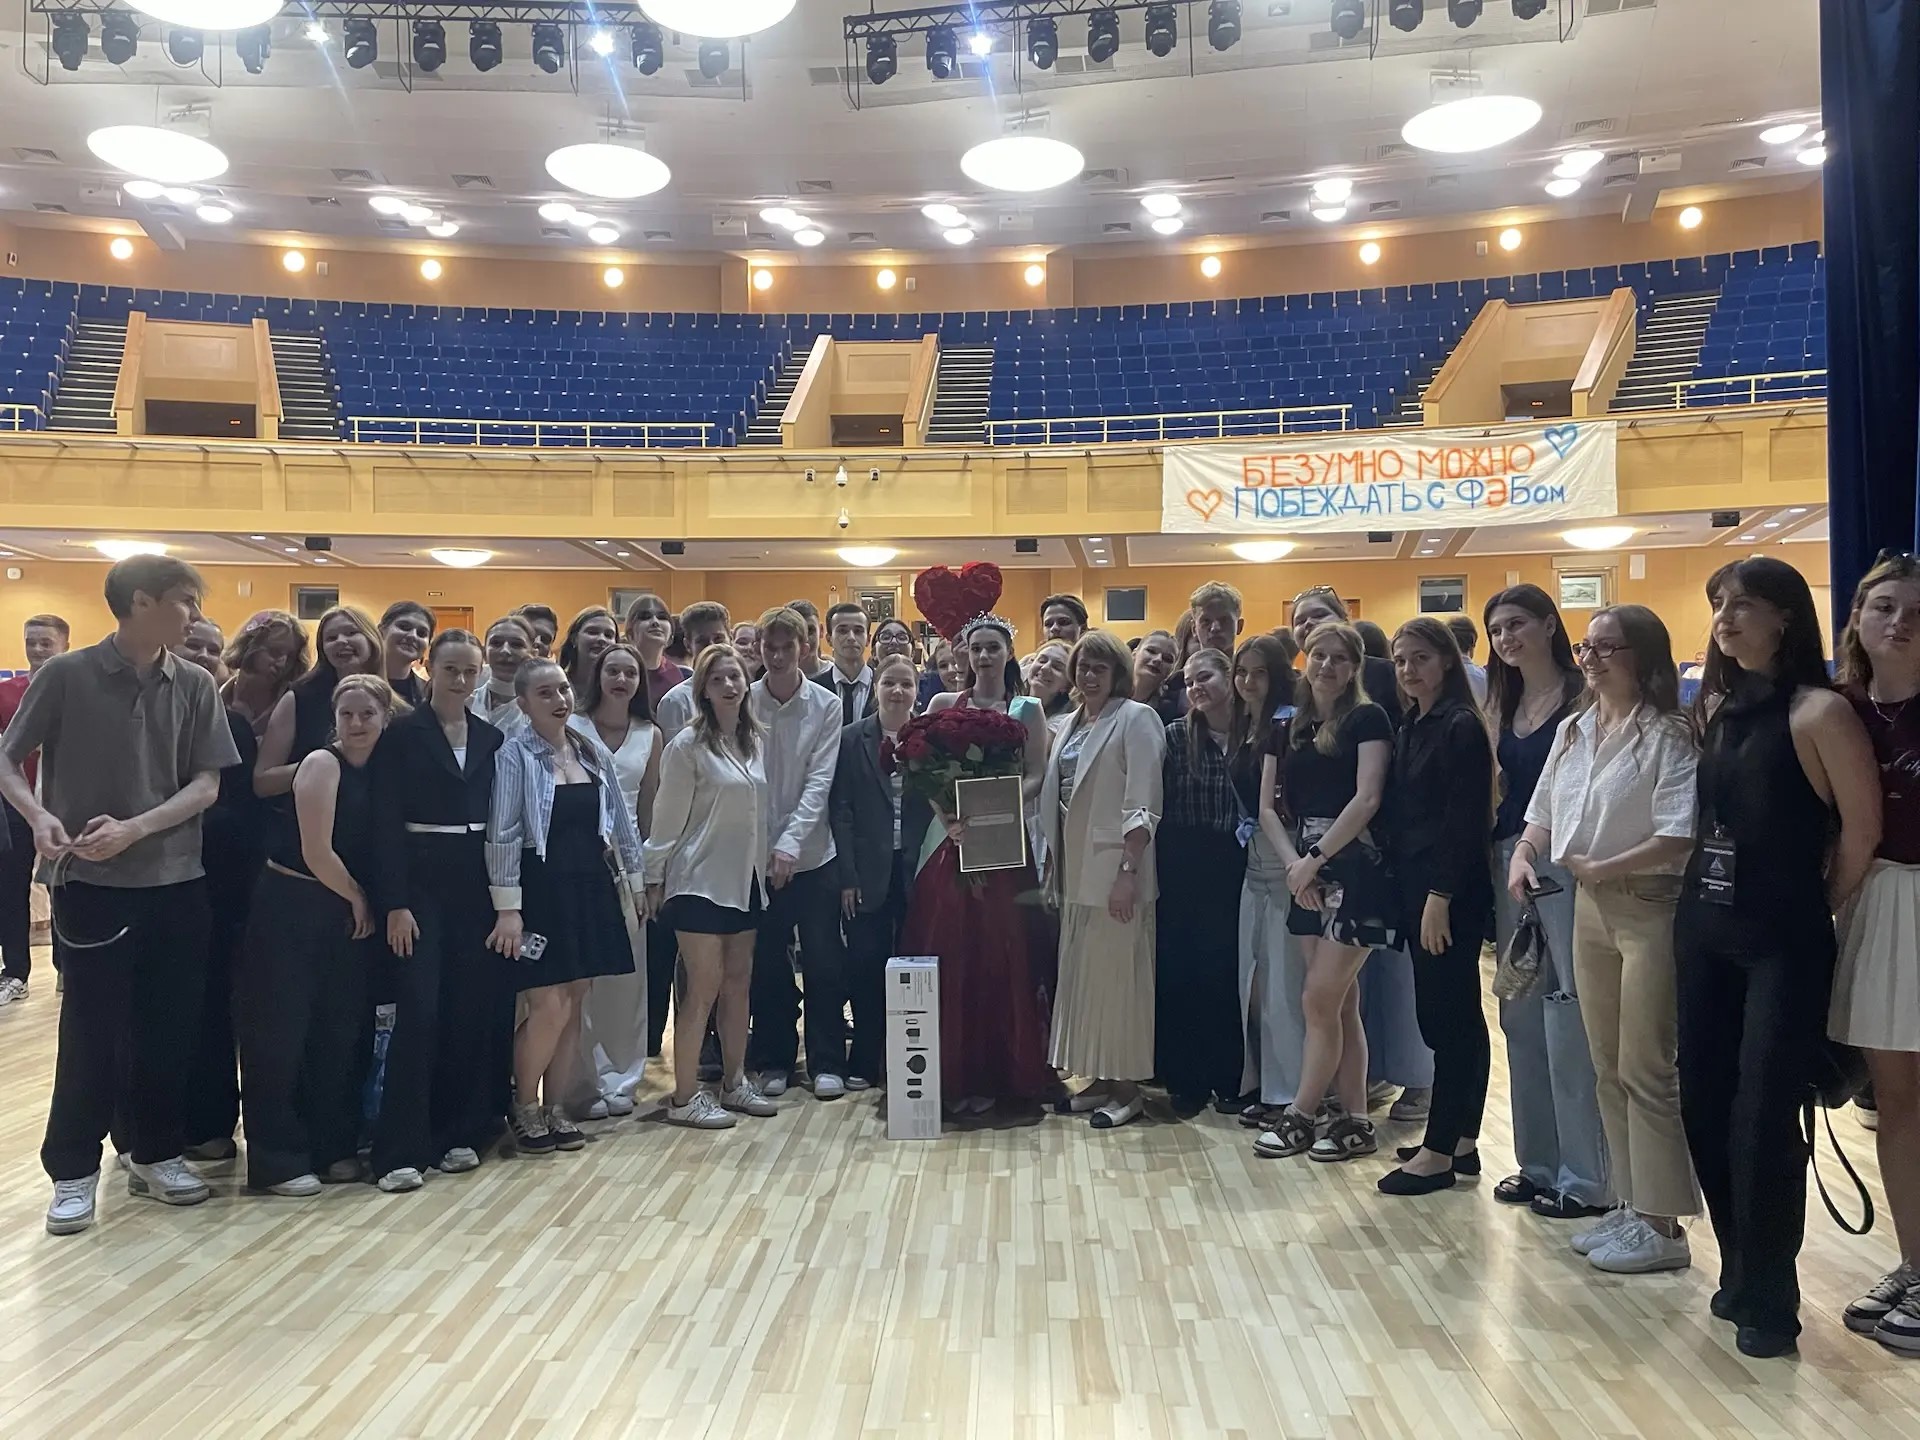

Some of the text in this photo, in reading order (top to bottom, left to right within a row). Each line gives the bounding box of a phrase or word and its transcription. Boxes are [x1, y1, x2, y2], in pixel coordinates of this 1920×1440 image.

[1243, 443, 1535, 488] БЕЗУМНО МОЖНО
[1235, 481, 1422, 518] ПОБЕЖДАТЬ
